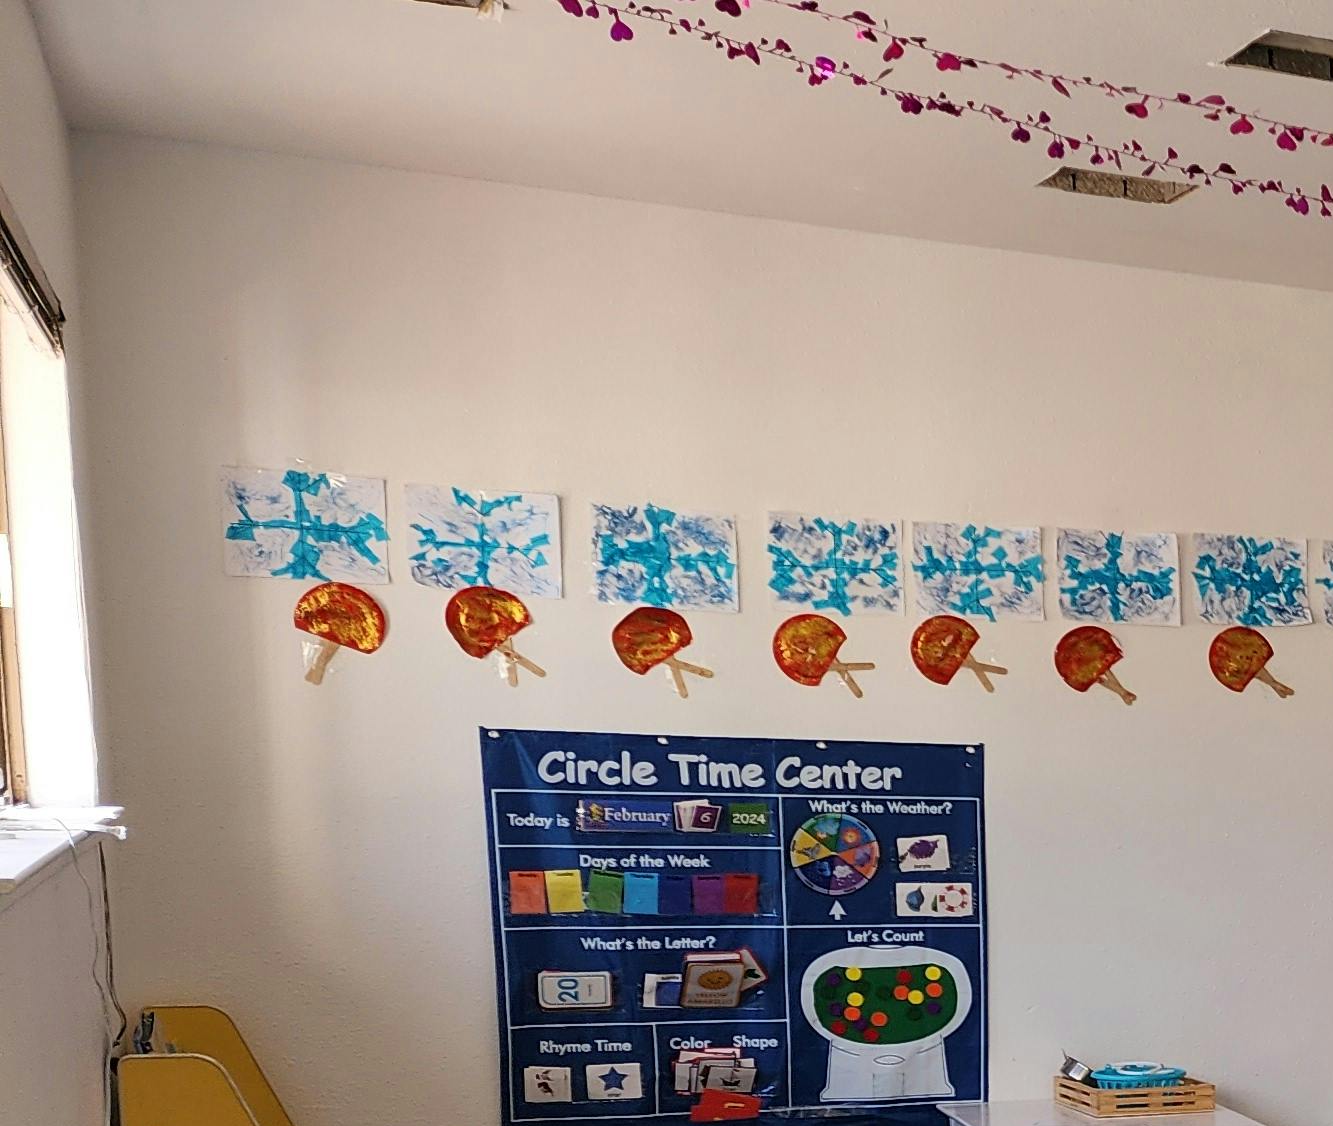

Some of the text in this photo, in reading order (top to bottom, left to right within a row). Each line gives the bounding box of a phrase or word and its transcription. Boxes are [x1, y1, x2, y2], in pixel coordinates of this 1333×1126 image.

[537, 750, 903, 791] Circle Time Center
[808, 800, 953, 815] What's the Weather?
[506, 813, 552, 828] Today
[557, 815, 570, 827] is
[604, 807, 672, 825] February
[732, 812, 767, 825] 2024
[579, 855, 712, 872] Days of the Week
[580, 936, 716, 951] What's the Letter?
[847, 930, 924, 943] Let's Count
[558, 977, 579, 1003] 20
[540, 1040, 632, 1057] Rhyme Time
[670, 1035, 778, 1050] Color Shape
